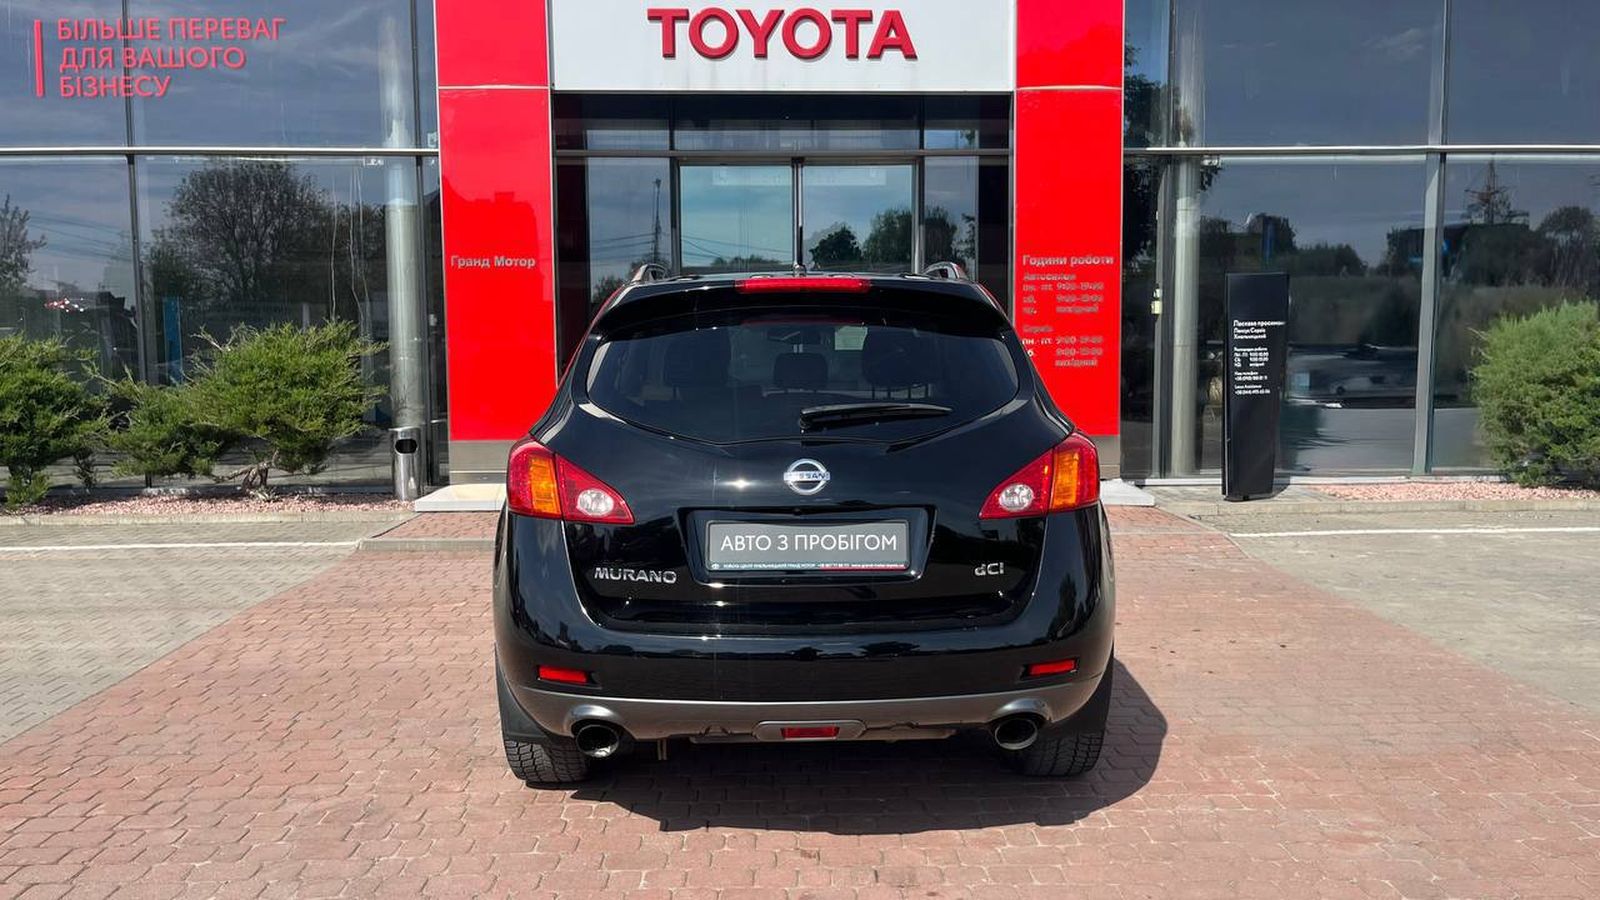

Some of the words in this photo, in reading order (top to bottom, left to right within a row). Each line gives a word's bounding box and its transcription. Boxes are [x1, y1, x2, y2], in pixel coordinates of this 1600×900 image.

[57, 18, 160, 41] БІЛЬШЕ
[168, 18, 286, 41] ПЕРЕВАГ
[647, 7, 918, 60] TOYOTA
[59, 46, 115, 73] ДЛЯ
[122, 46, 246, 70] ВАШОГО
[59, 75, 171, 98] БІЗНЕСУ
[450, 255, 490, 269] Гранд
[494, 256, 536, 269] Мотор
[1022, 254, 1067, 267] Години
[1070, 254, 1114, 268] роботи
[720, 535, 772, 551] АВТО
[794, 534, 897, 551] ПРОБІГОМ
[594, 567, 677, 584] MURANO
